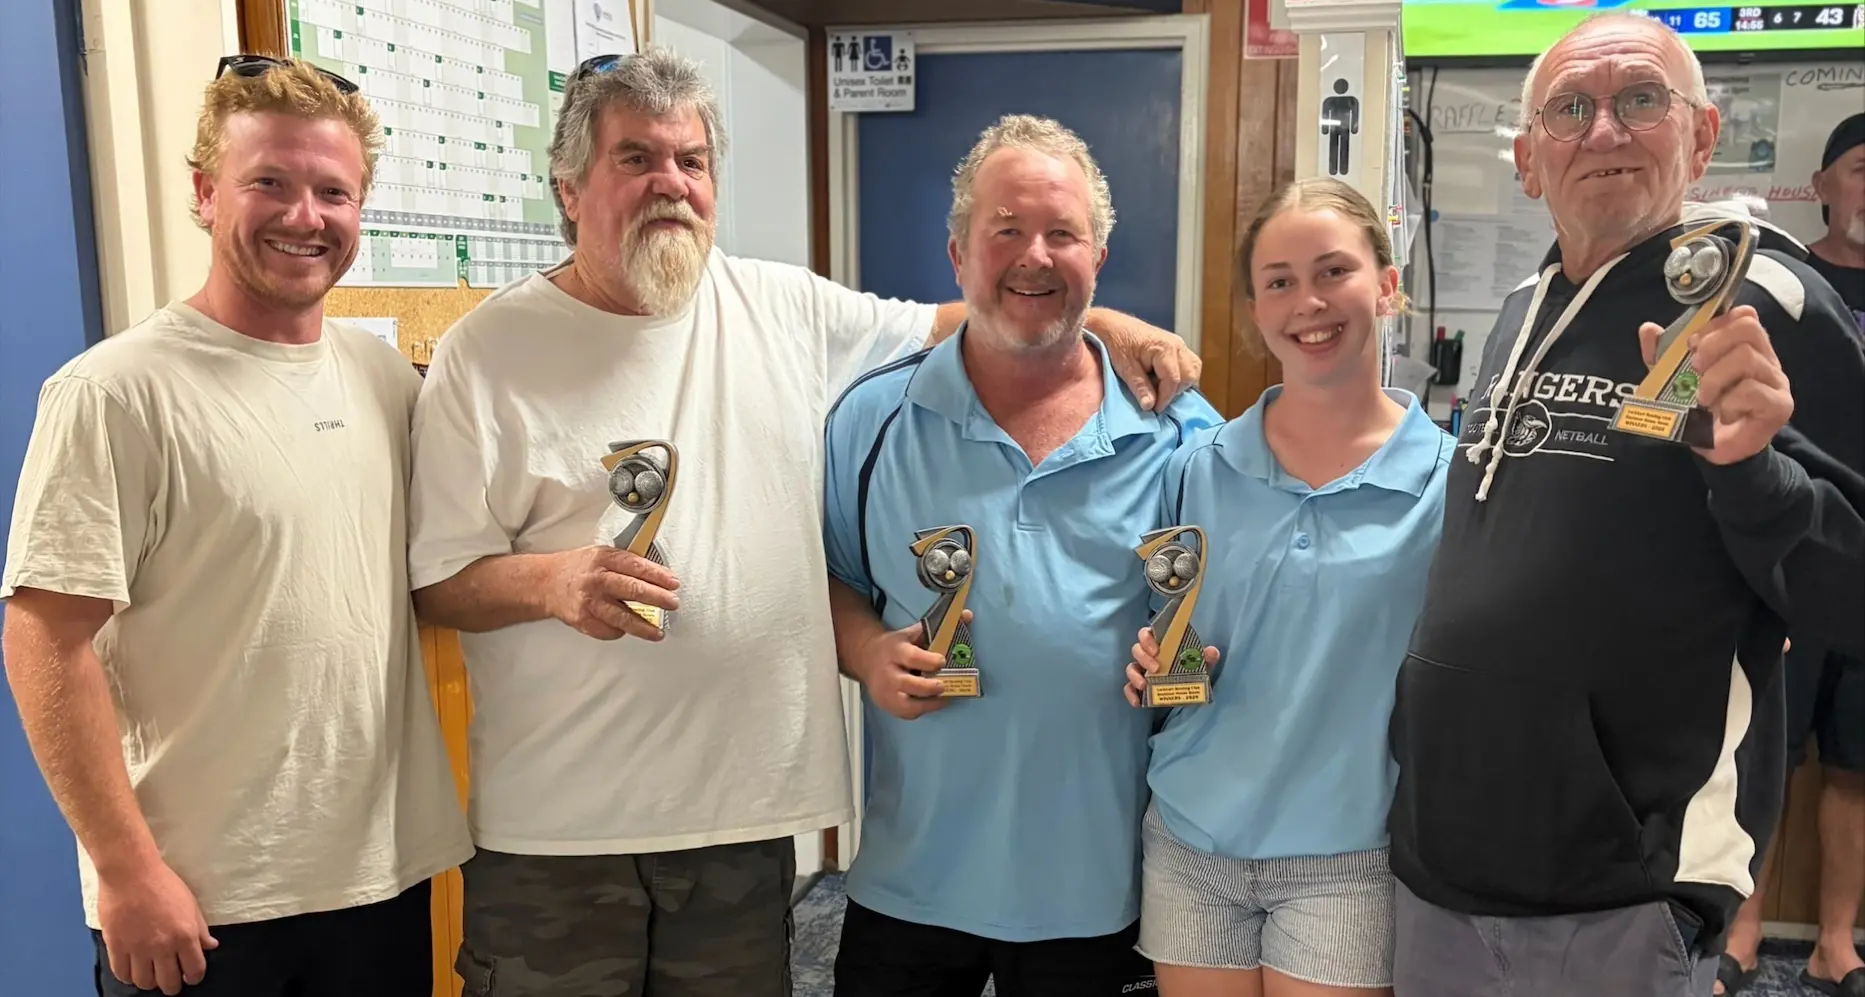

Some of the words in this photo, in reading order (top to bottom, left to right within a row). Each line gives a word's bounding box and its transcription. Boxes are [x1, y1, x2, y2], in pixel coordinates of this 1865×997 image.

[1738, 7, 1761, 18] 3RD
[1773, 12, 1783, 24] 6
[1793, 12, 1802, 23] 7
[1815, 8, 1844, 26] 43
[1669, 15, 1682, 26] 11
[1694, 12, 1721, 28] 65
[833, 76, 866, 87] Unisex
[868, 75, 895, 86] Toilet
[834, 88, 840, 98] &
[843, 88, 875, 98] Parent
[877, 87, 907, 98] Room
[314, 418, 345, 432] THRILLS
[1555, 429, 1609, 446] NETBALL
